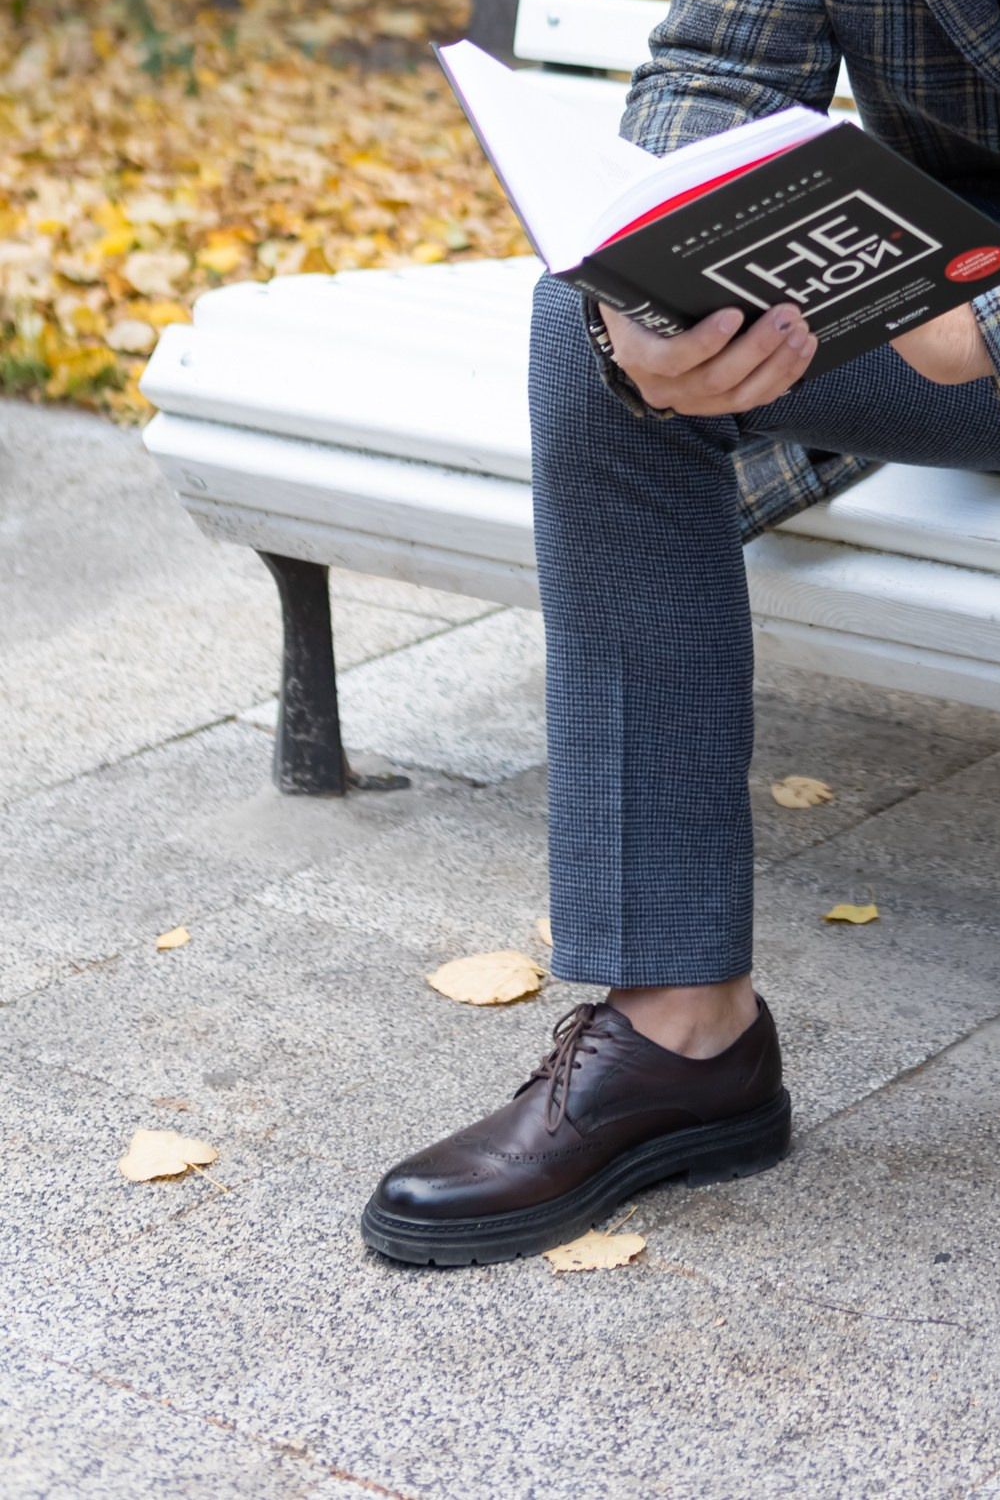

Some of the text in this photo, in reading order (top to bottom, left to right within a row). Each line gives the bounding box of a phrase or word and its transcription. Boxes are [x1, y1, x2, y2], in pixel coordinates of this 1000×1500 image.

[672, 223, 722, 253] ДЖЕН
[735, 170, 824, 219] СИНСЕРО
[745, 215, 879, 289] НЕ
[784, 238, 902, 304] НОЙ
